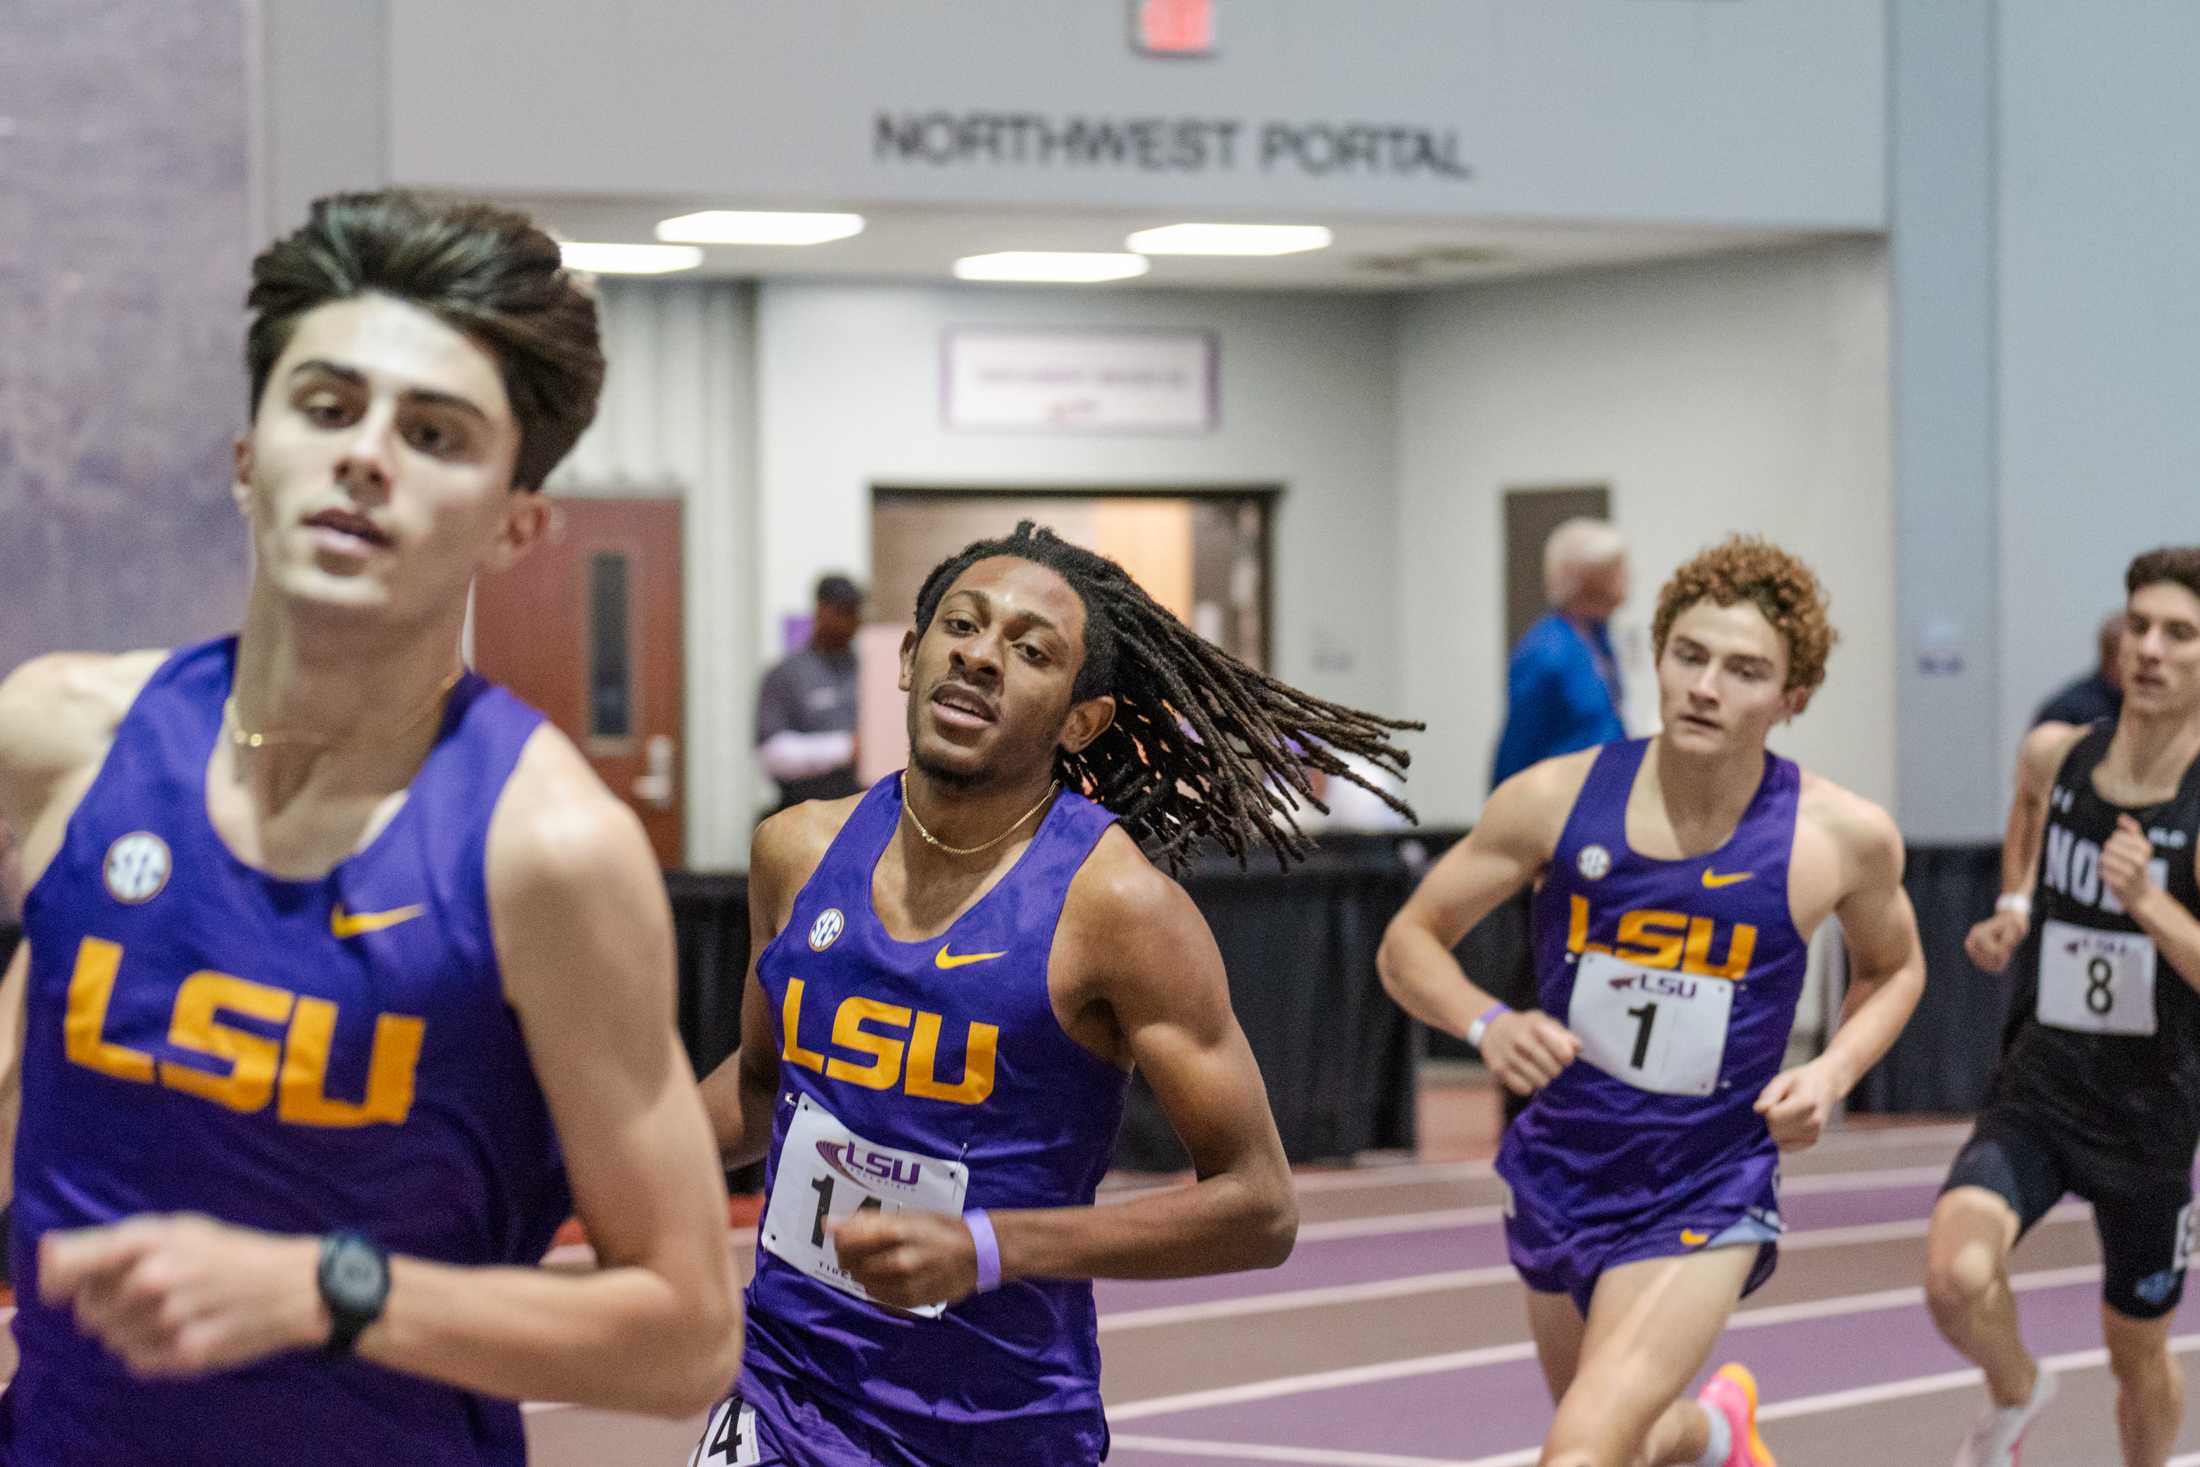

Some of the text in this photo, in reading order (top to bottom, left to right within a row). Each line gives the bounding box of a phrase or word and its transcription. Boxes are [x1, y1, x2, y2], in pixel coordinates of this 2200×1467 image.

[874, 110, 1476, 180] NORTHWEST PORTAL
[1567, 895, 1758, 981] LSU
[1640, 974, 1698, 1001] LSU
[2086, 957, 2113, 1015] 8
[64, 935, 426, 1128] LSU
[782, 976, 1000, 1106] LSU
[1627, 1001, 1658, 1070] 1
[845, 1141, 921, 1185] LSU
[811, 1174, 882, 1249] 1
